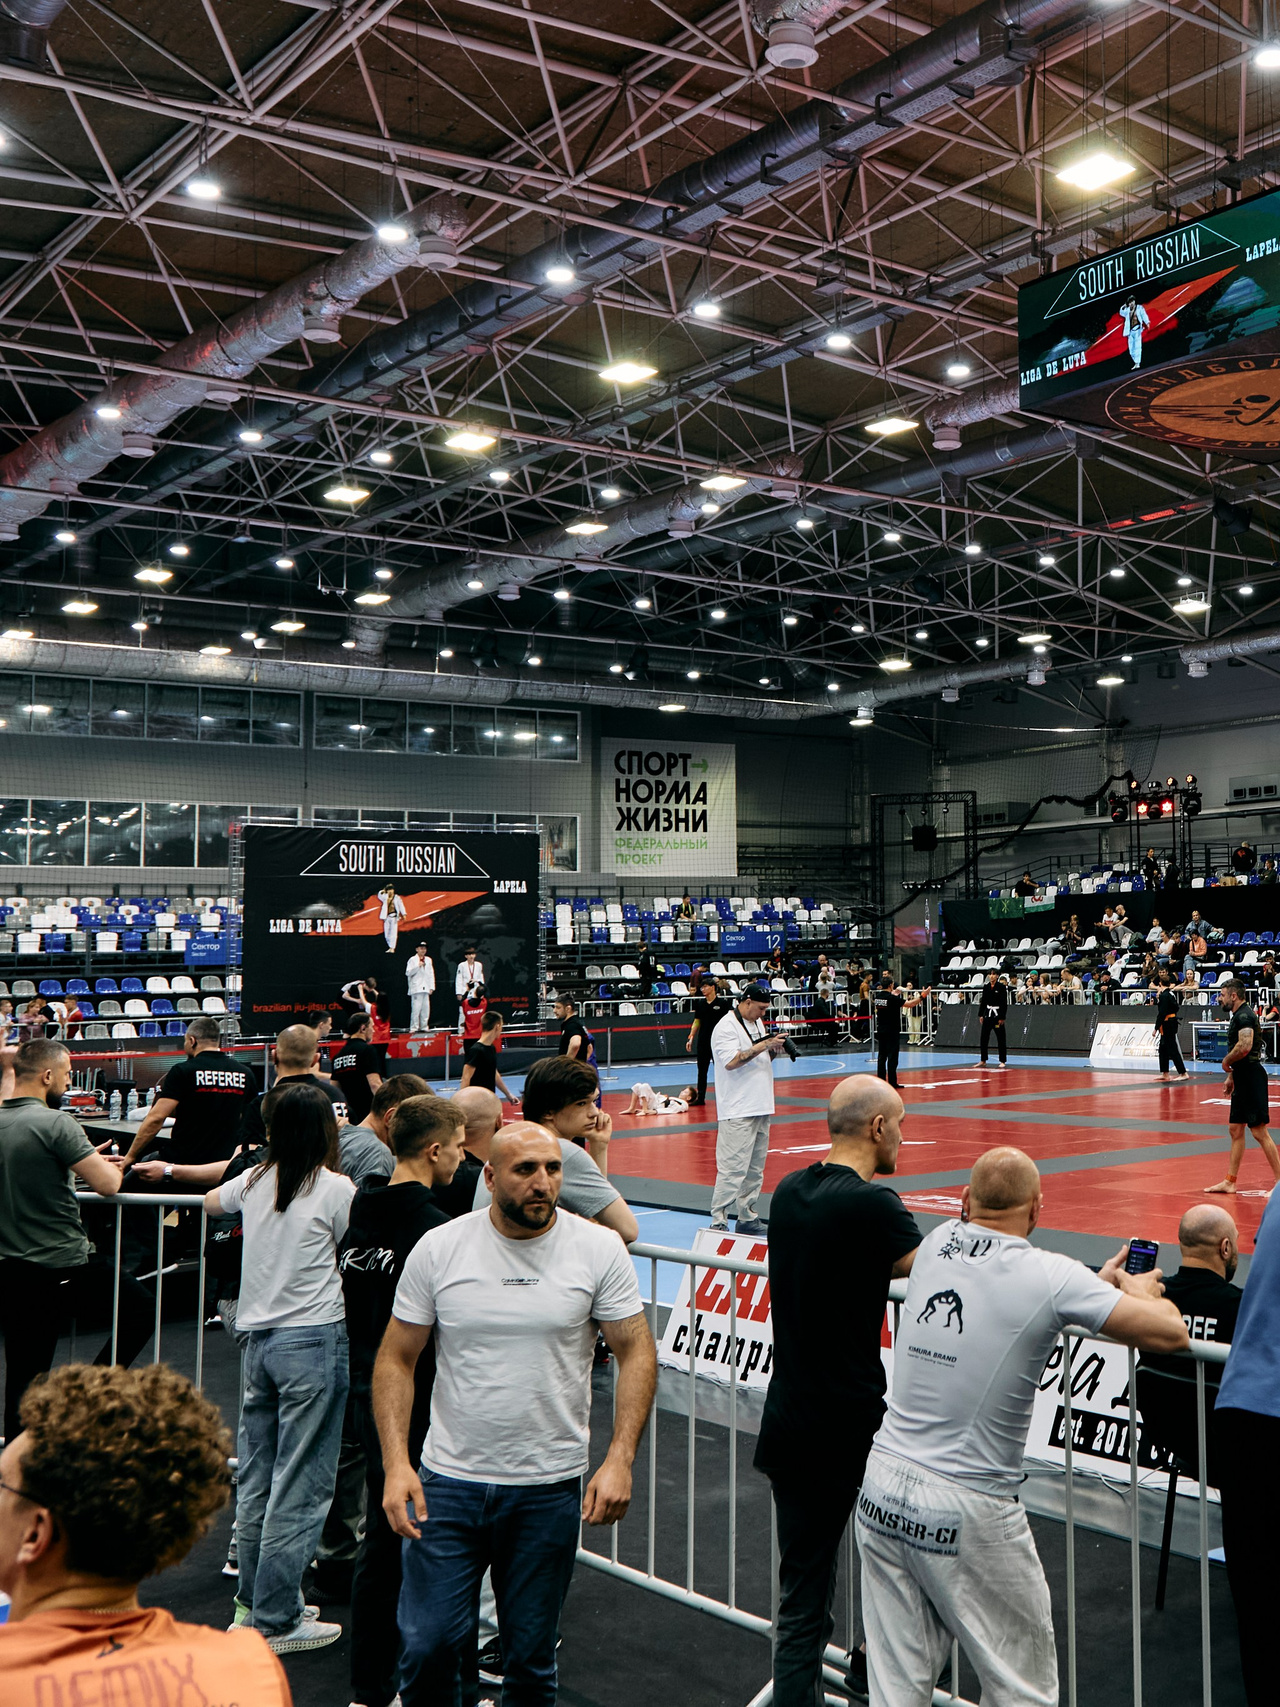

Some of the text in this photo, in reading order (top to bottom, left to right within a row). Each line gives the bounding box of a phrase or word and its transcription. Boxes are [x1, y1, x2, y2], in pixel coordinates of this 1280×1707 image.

[1078, 228, 1200, 301] SOUTH RUSSIAN
[1020, 351, 1087, 386] LIGA DE LUTA
[614, 750, 691, 777] СПОРТ
[615, 778, 707, 805] НОРМА
[615, 807, 708, 833] ЖИЗНИ
[615, 837, 708, 850] ФЕДЕРАЛЬНЫЙ
[339, 844, 456, 873] SOUTH RUSSIAN
[615, 854, 663, 864] ПРОЕКТ
[493, 880, 527, 893] LAPELA
[269, 919, 342, 933] LIGA DE LUTA
[191, 943, 220, 951] Сектор
[766, 934, 780, 949] 12
[1260, 988, 1267, 1003] 4
[252, 1003, 292, 1013] brazilian
[293, 1002, 326, 1014] jiu-jitsu
[1097, 1027, 1134, 1055] Lapela
[196, 1071, 246, 1088] REFEREE
[908, 1345, 957, 1363] KIMURA BRAND
[859, 1492, 958, 1545] MONSTER-GI
